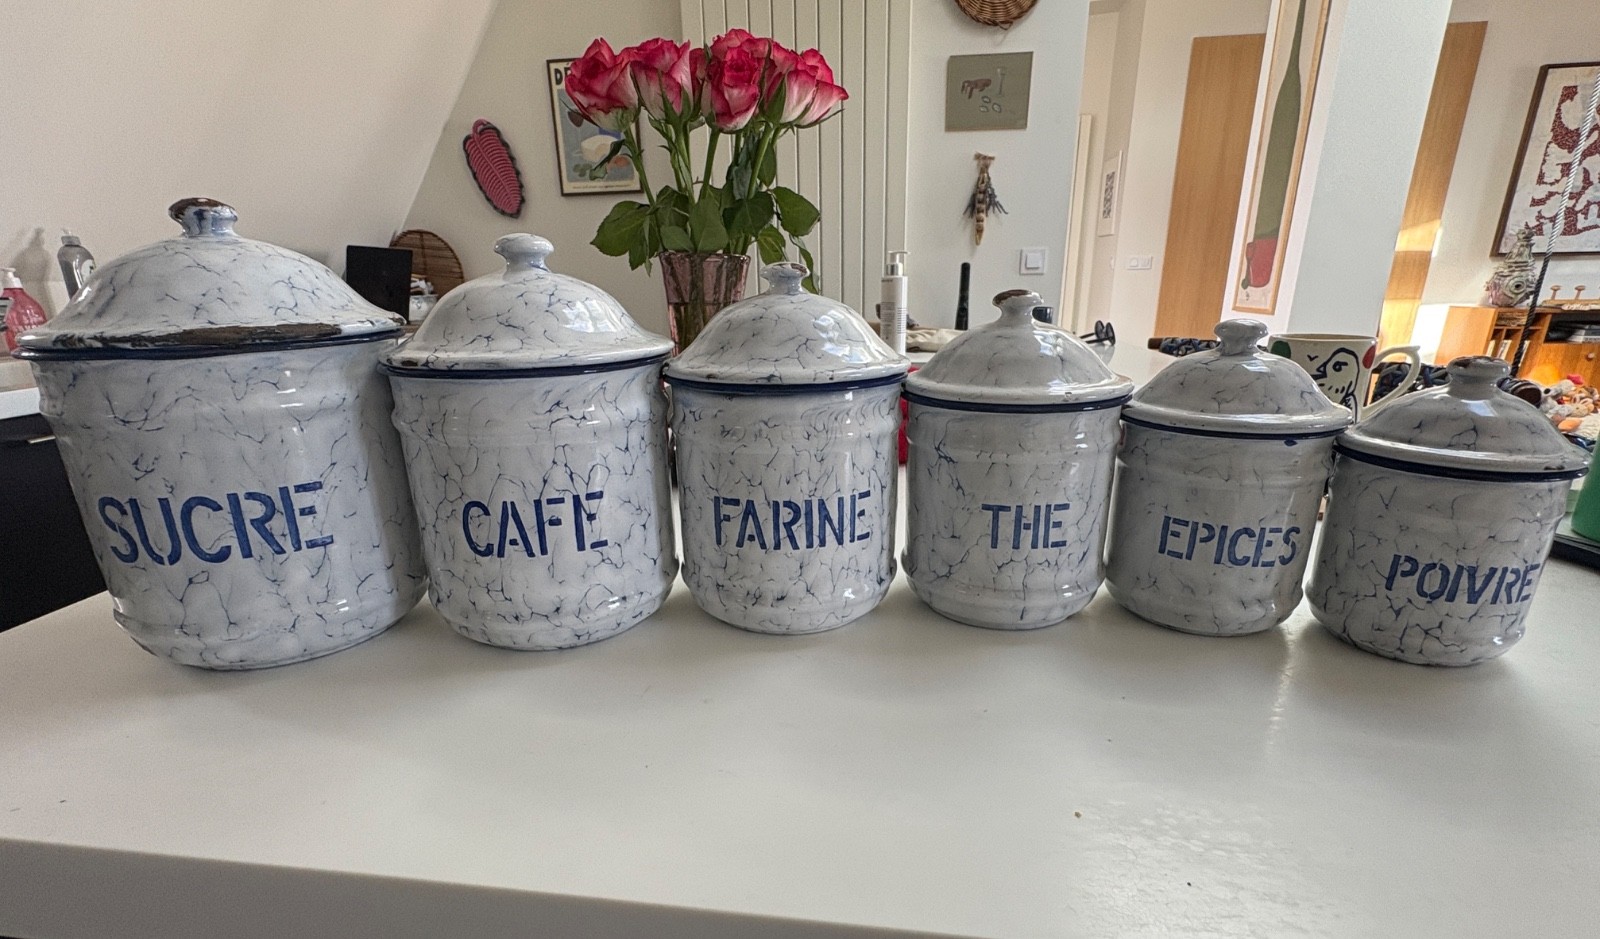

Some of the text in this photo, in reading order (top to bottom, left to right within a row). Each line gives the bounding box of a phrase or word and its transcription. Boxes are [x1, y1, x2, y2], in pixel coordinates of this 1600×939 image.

[98, 481, 334, 566] SUCRE
[462, 490, 608, 558] CAFE
[714, 490, 870, 550] FARINE
[981, 503, 1070, 549] THE
[1158, 515, 1300, 567] EPICES
[1385, 554, 1540, 604] POIVRE
